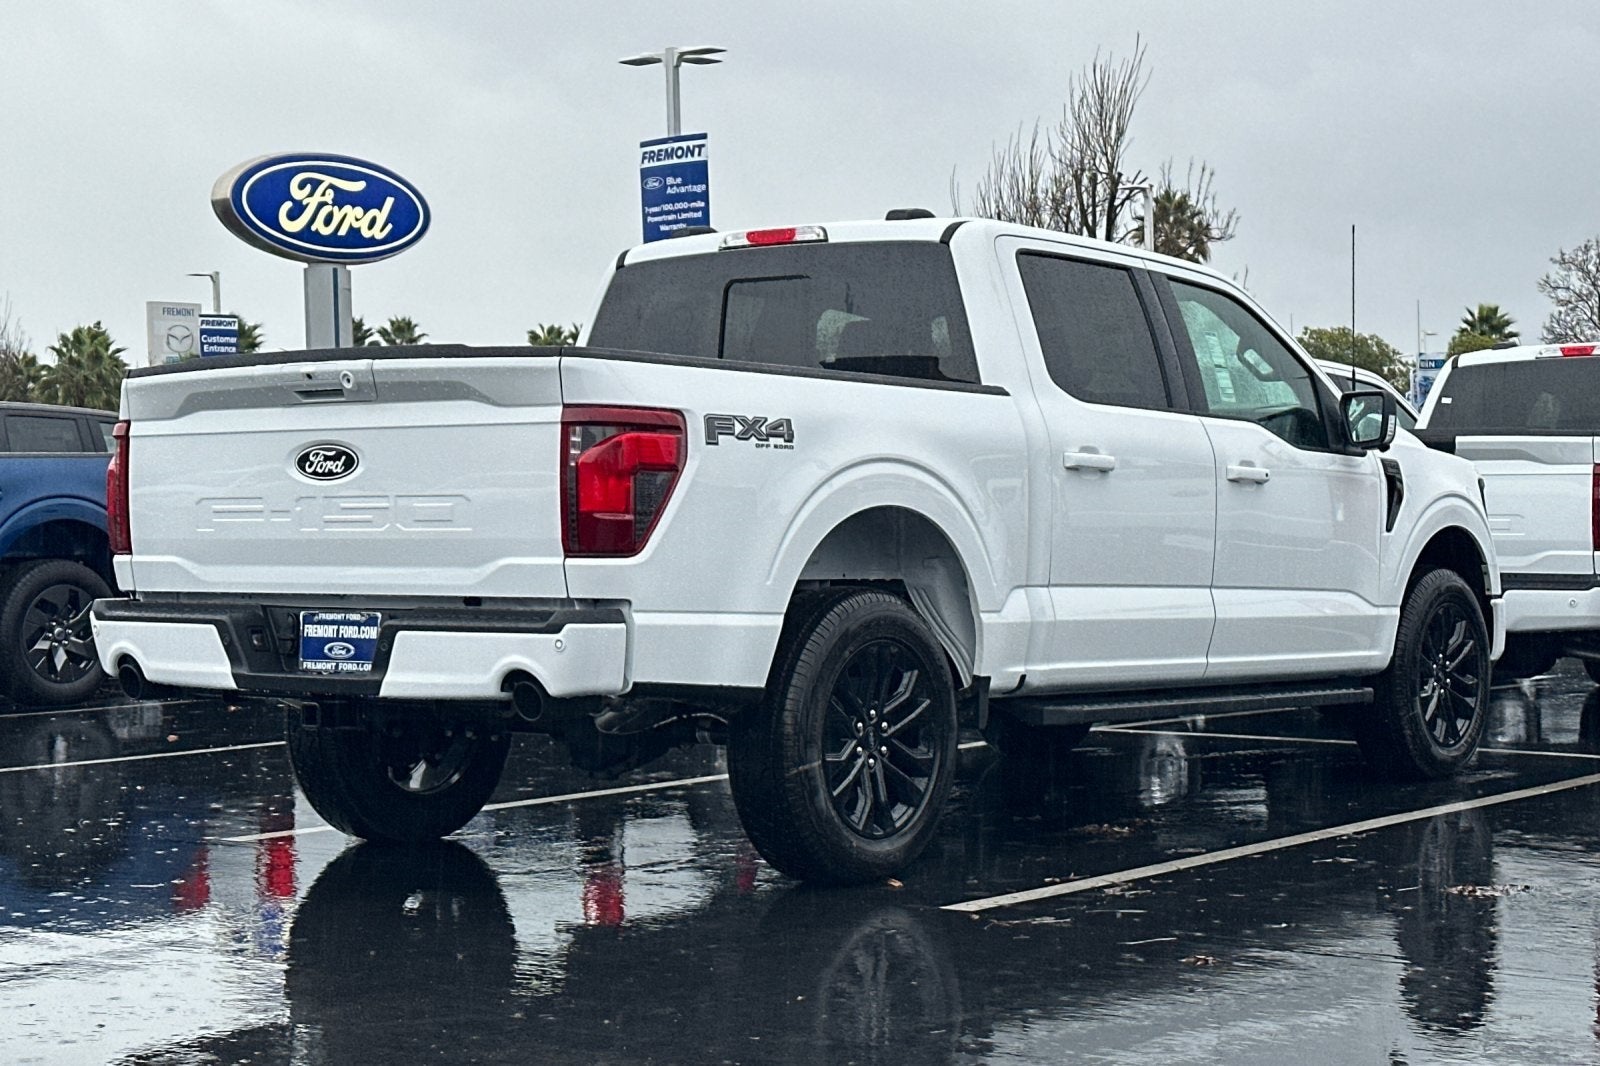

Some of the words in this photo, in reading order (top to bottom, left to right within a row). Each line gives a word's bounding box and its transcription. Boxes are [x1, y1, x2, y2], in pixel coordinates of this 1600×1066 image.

[641, 143, 706, 164] FREMONT
[666, 177, 682, 185] Blue
[666, 183, 706, 195] Advantage
[278, 171, 395, 240] Ford
[647, 213, 677, 223] Powertrain
[677, 210, 702, 220] Limited
[162, 307, 195, 317] FREMONT
[200, 319, 237, 327] FREMONT
[201, 335, 237, 343] Customer
[203, 344, 237, 353] Entrance
[703, 413, 795, 446] FX4
[305, 449, 347, 475] Ford
[195, 494, 473, 532] F-150
[346, 613, 361, 621] FORD
[303, 624, 338, 638] FREMONT
[339, 625, 378, 639] FORD.COM
[303, 661, 336, 670] FREMONT
